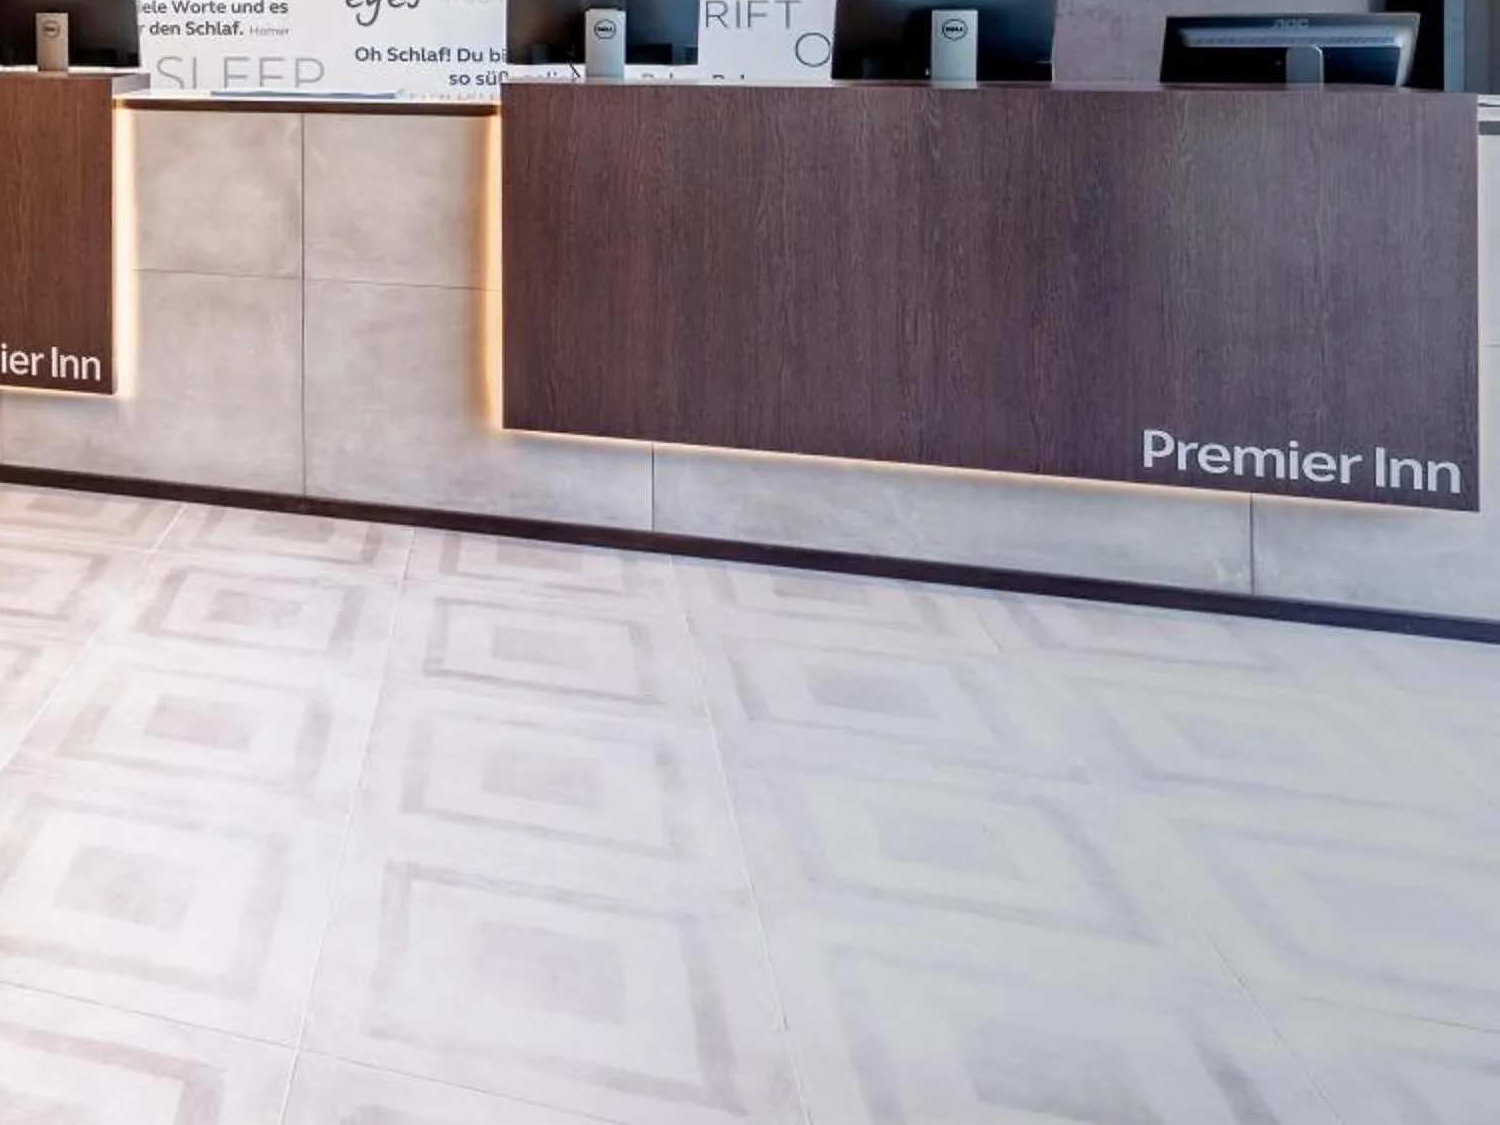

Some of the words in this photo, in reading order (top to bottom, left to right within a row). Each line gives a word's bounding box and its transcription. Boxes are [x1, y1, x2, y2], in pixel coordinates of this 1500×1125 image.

[172, 0, 227, 14] Worte
[231, 0, 265, 14] und
[269, 3, 289, 14] es
[705, 0, 802, 29] RIFT
[150, 22, 181, 36] den
[186, 21, 244, 36] Schlaf.
[355, 47, 382, 62] Oh
[387, 47, 451, 62] Schlaf!
[457, 49, 483, 62] Du
[449, 74, 471, 86] so
[52, 347, 101, 381] Inn
[1143, 429, 1362, 484] Premier
[1375, 447, 1461, 494] Inn
